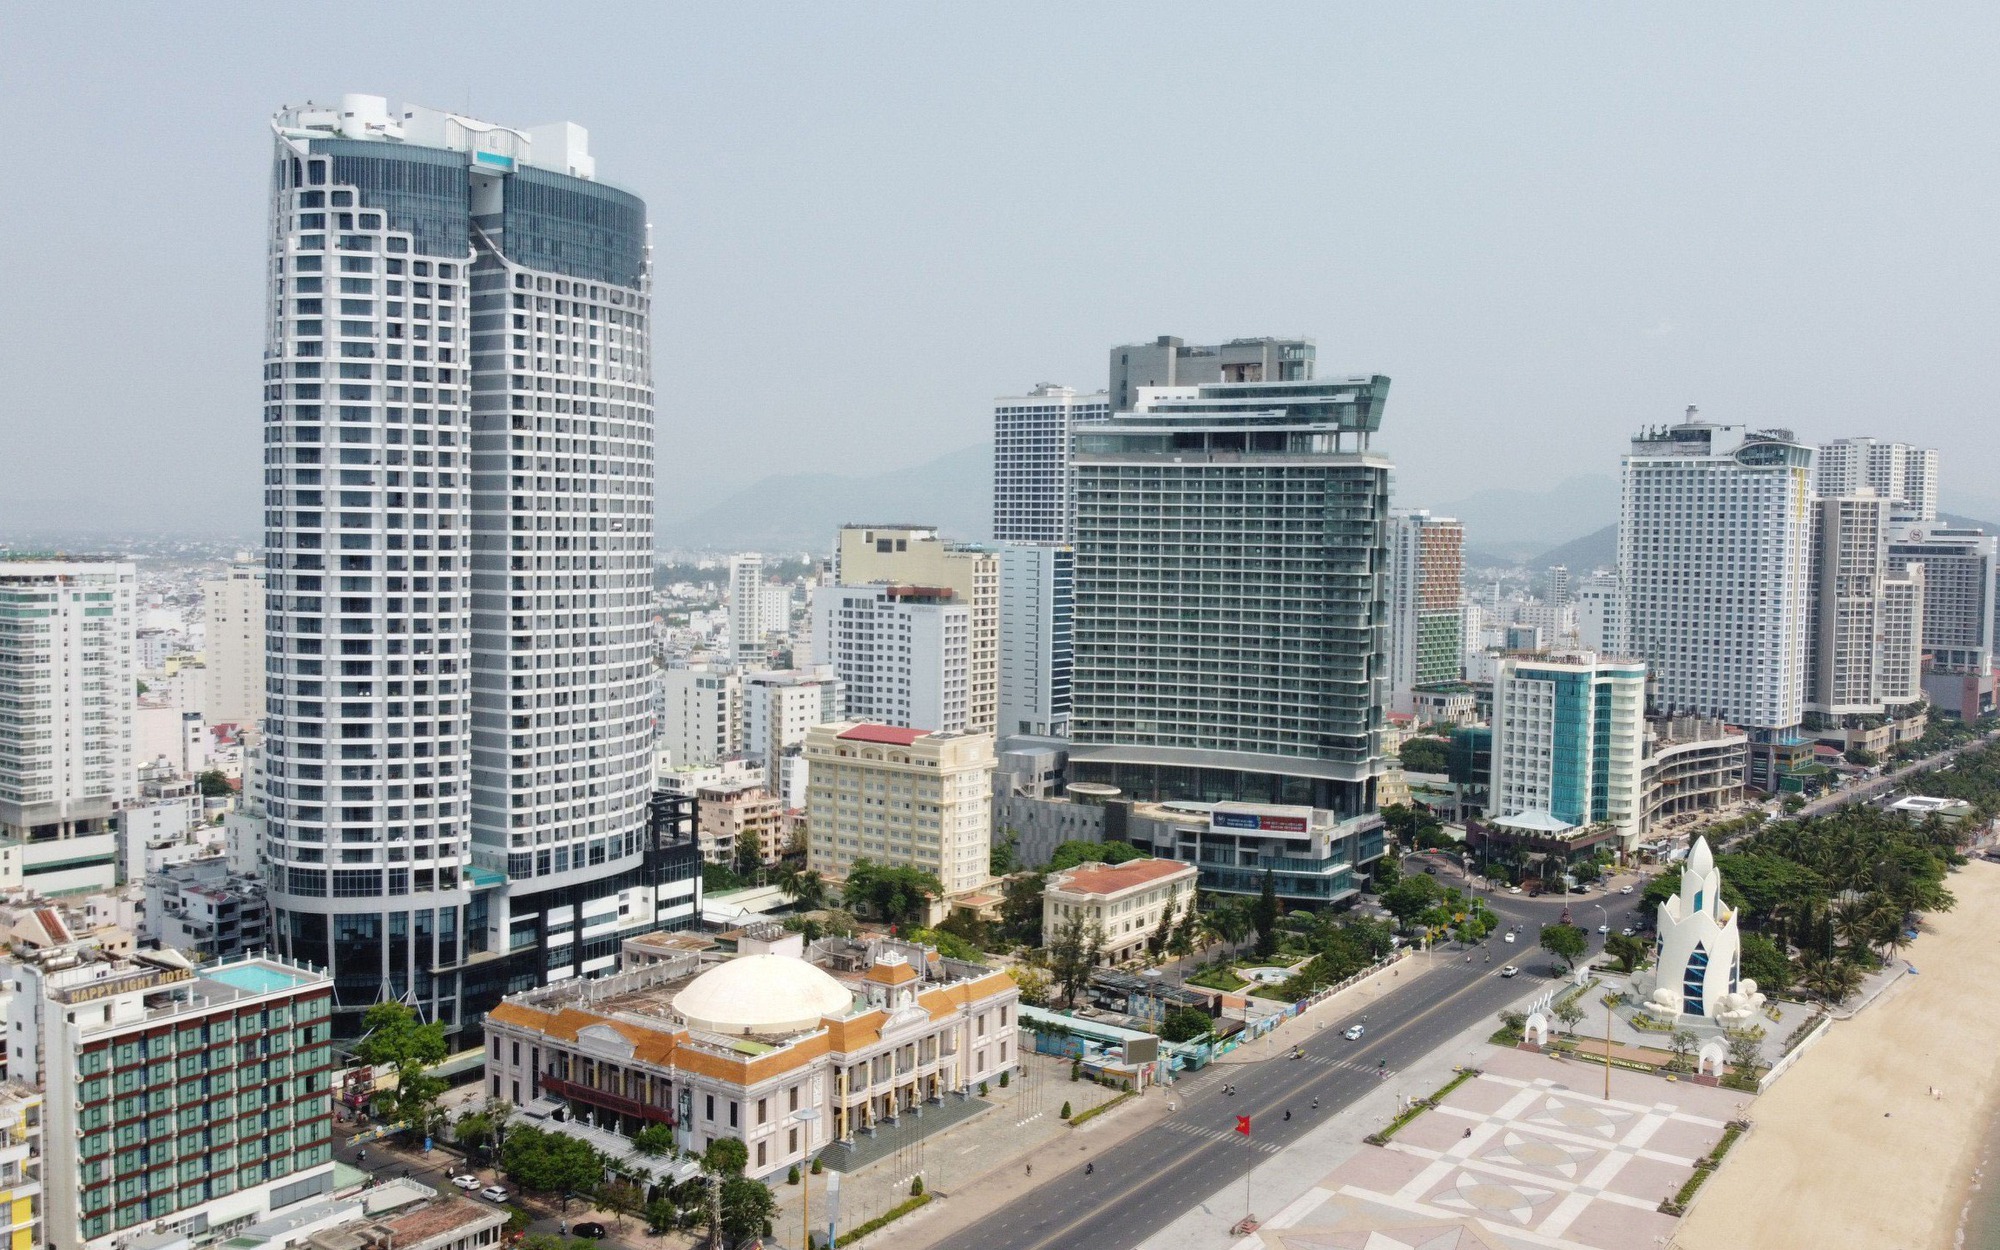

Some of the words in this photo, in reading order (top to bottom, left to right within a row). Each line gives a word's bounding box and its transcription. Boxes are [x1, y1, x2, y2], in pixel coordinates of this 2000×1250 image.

[1548, 655, 1565, 664] LODGE
[1566, 655, 1584, 666] HOTEL
[71, 983, 114, 1003] HAPPY
[117, 975, 154, 994] LIGHT
[158, 967, 194, 985] HOTEL
